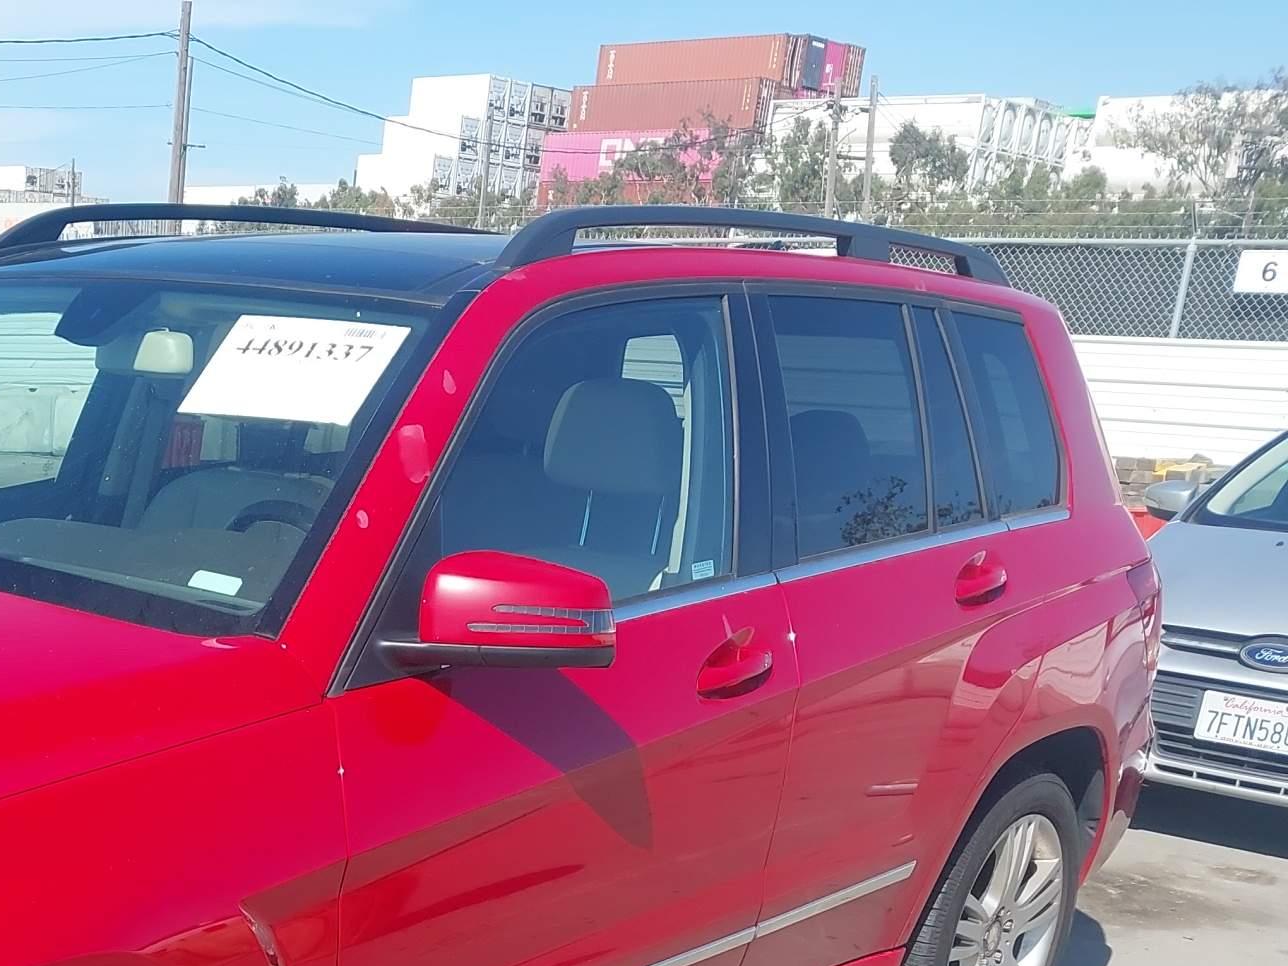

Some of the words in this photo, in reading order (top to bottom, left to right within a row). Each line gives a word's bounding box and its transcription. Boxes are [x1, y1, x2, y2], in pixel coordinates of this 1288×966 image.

[1261, 261, 1279, 282] 6
[236, 338, 374, 362] 44891337
[1224, 696, 1284, 715] California
